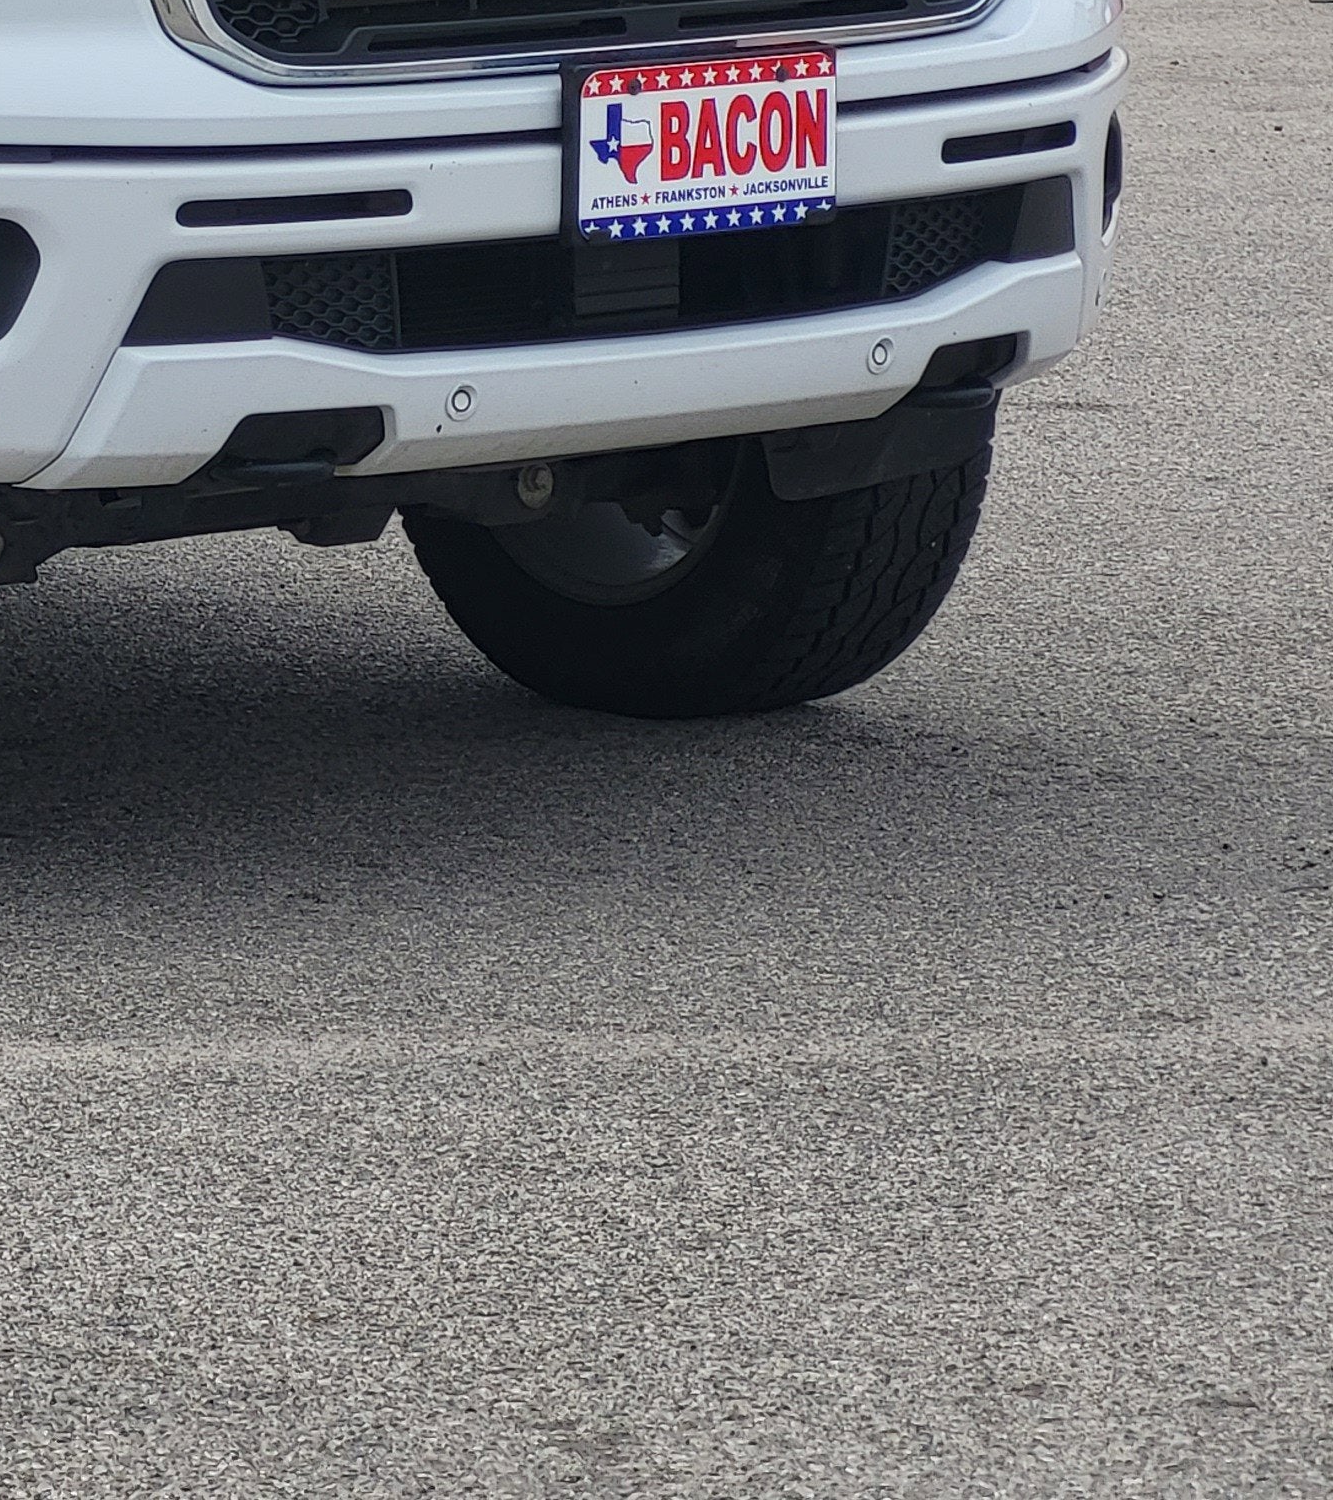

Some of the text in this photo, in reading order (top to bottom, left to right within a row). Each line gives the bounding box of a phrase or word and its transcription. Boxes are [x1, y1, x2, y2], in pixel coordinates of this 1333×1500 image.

[660, 88, 827, 181] BACON
[591, 176, 829, 210] ATHENS FRANKSTON JACKSONVILLE
